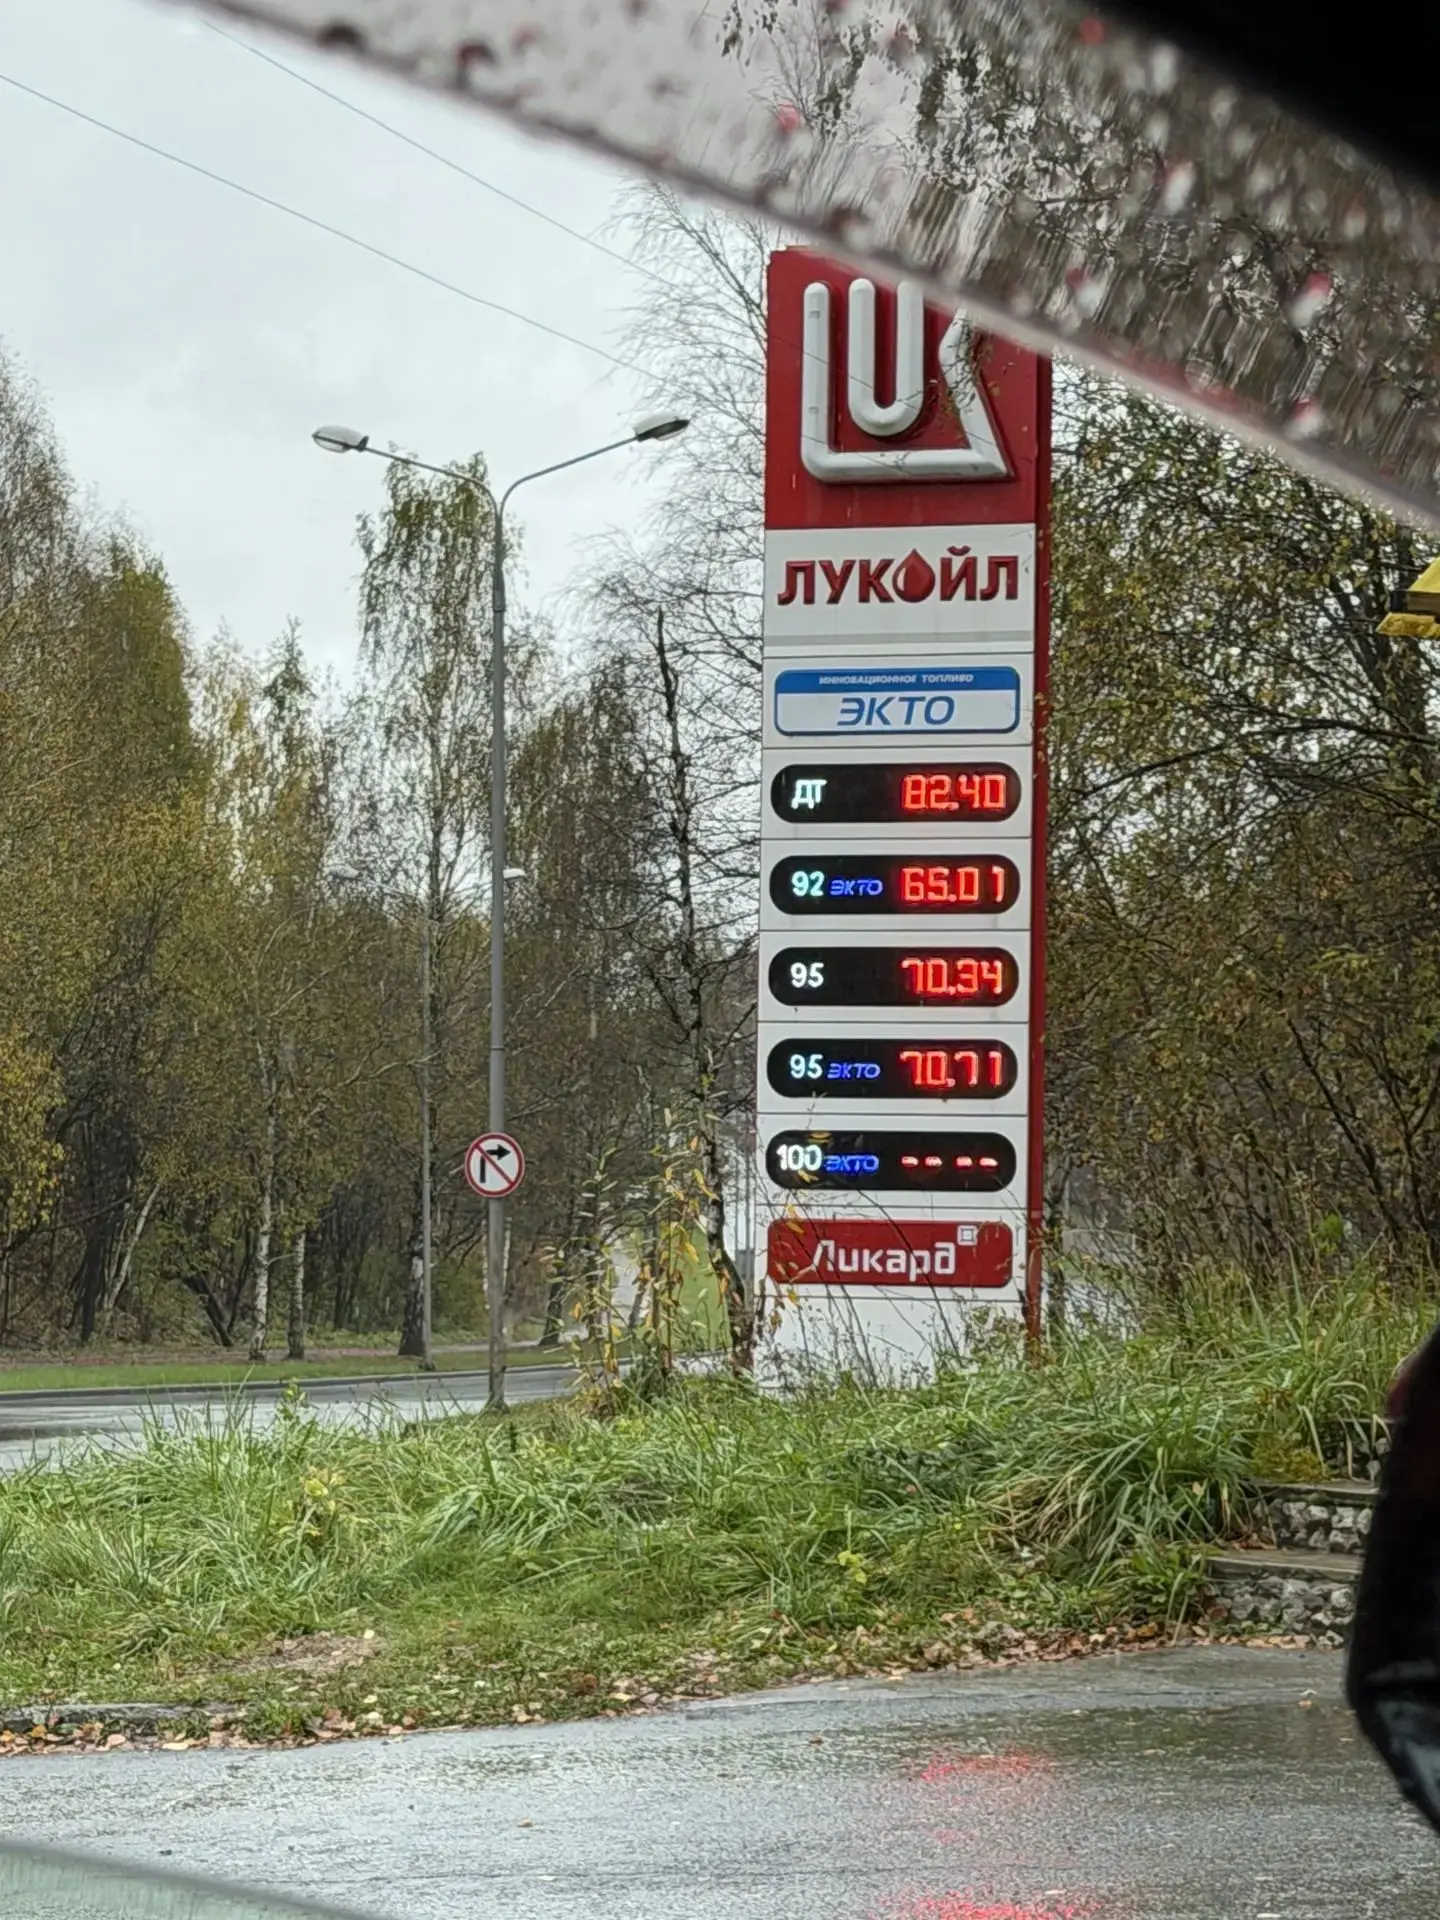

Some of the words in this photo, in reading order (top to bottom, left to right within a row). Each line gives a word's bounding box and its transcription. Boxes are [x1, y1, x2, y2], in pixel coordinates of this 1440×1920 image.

[777, 545, 1018, 605] ЛУКОЙЛ
[922, 673, 974, 684] ТОПЛИВО
[837, 695, 955, 726] ЭКТО
[791, 779, 828, 809] ДТ
[903, 774, 1007, 811] 82.40
[791, 871, 825, 897] 92
[829, 878, 884, 896] ЭКТО
[902, 866, 1005, 903] 65.01
[790, 962, 824, 988] 95
[901, 957, 1003, 996] 70.34
[789, 1054, 824, 1079] 95
[827, 1062, 881, 1079] ЭКТО
[900, 1051, 1003, 1088] 70.71
[776, 1144, 822, 1171] 100
[824, 1154, 880, 1174] ЭКТО
[812, 1239, 956, 1282] Ликард
